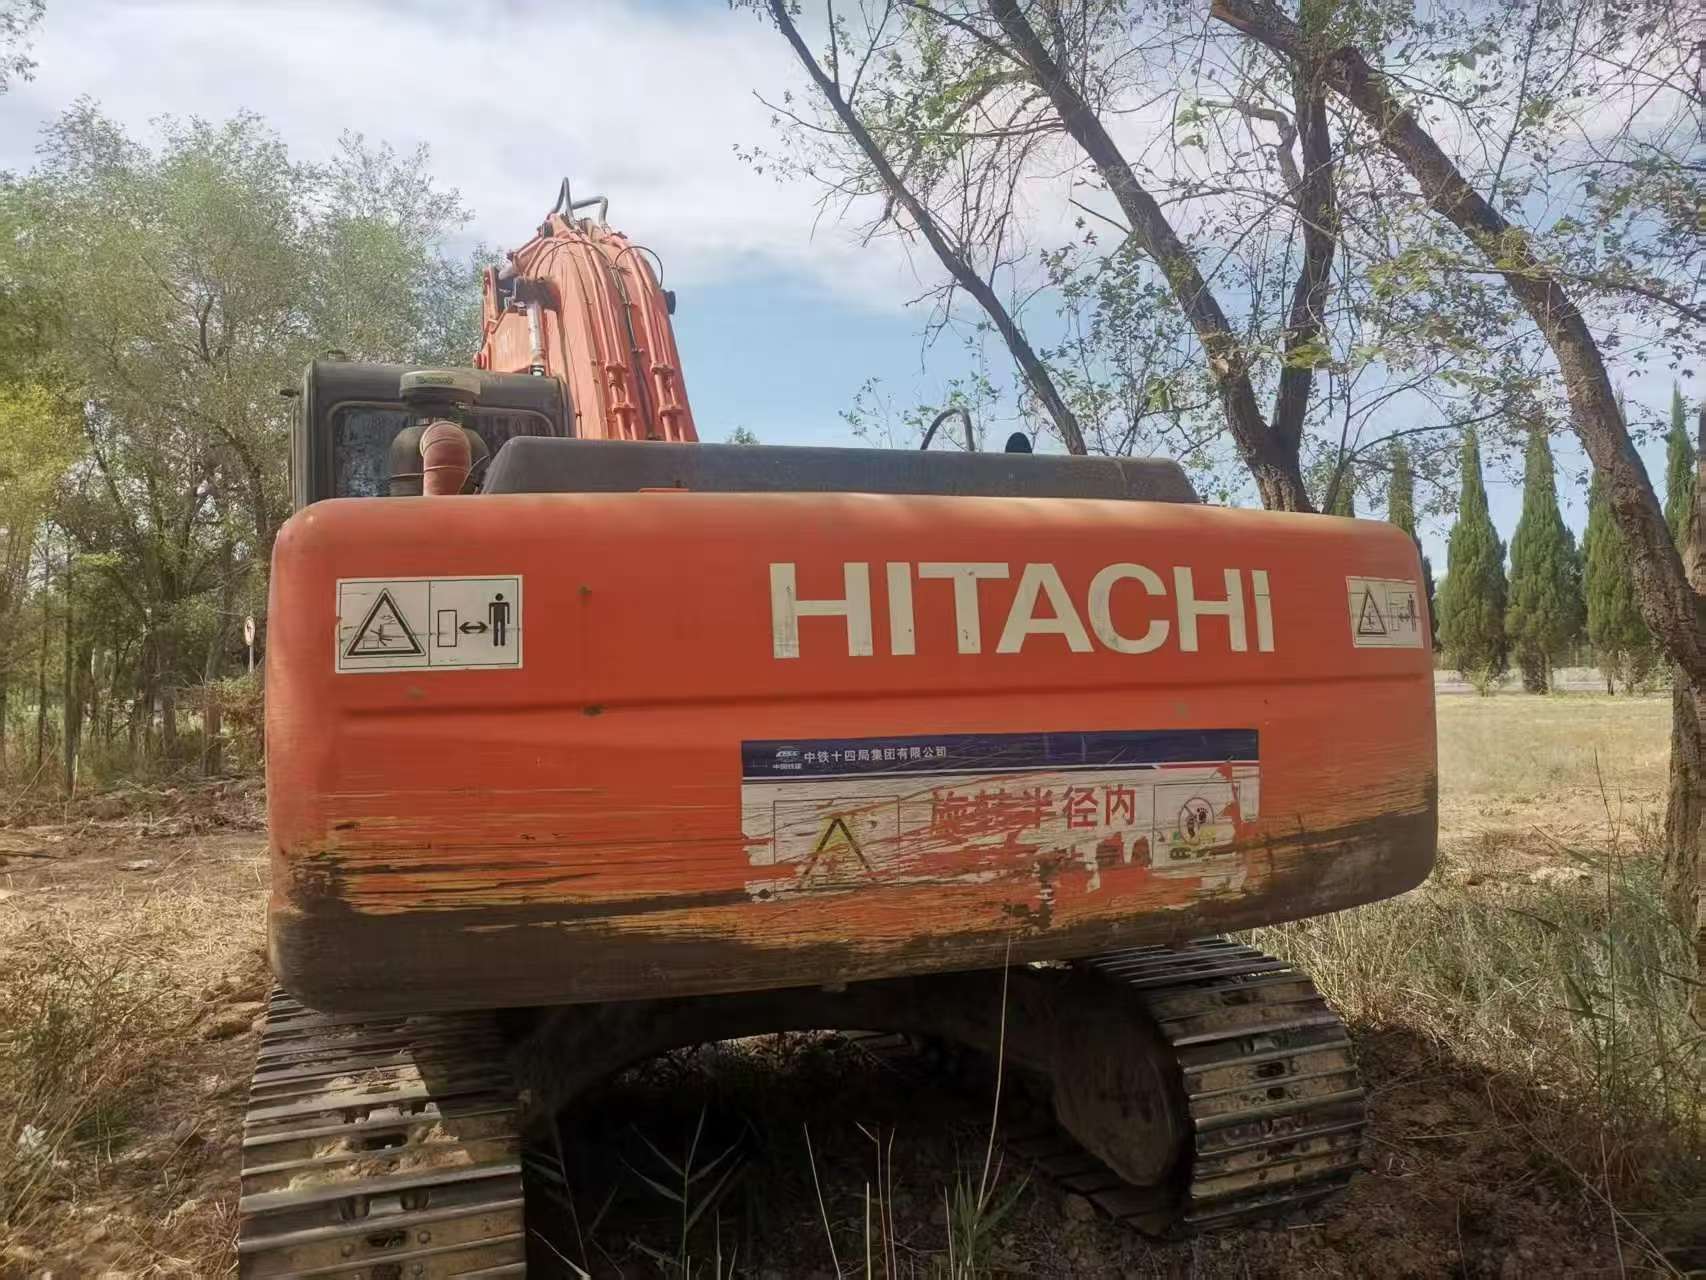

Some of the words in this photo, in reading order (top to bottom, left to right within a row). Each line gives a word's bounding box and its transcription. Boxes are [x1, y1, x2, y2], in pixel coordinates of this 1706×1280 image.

[769, 562, 1275, 658] HITACHI
[804, 746, 947, 764] 中铁十四局集团有限公司
